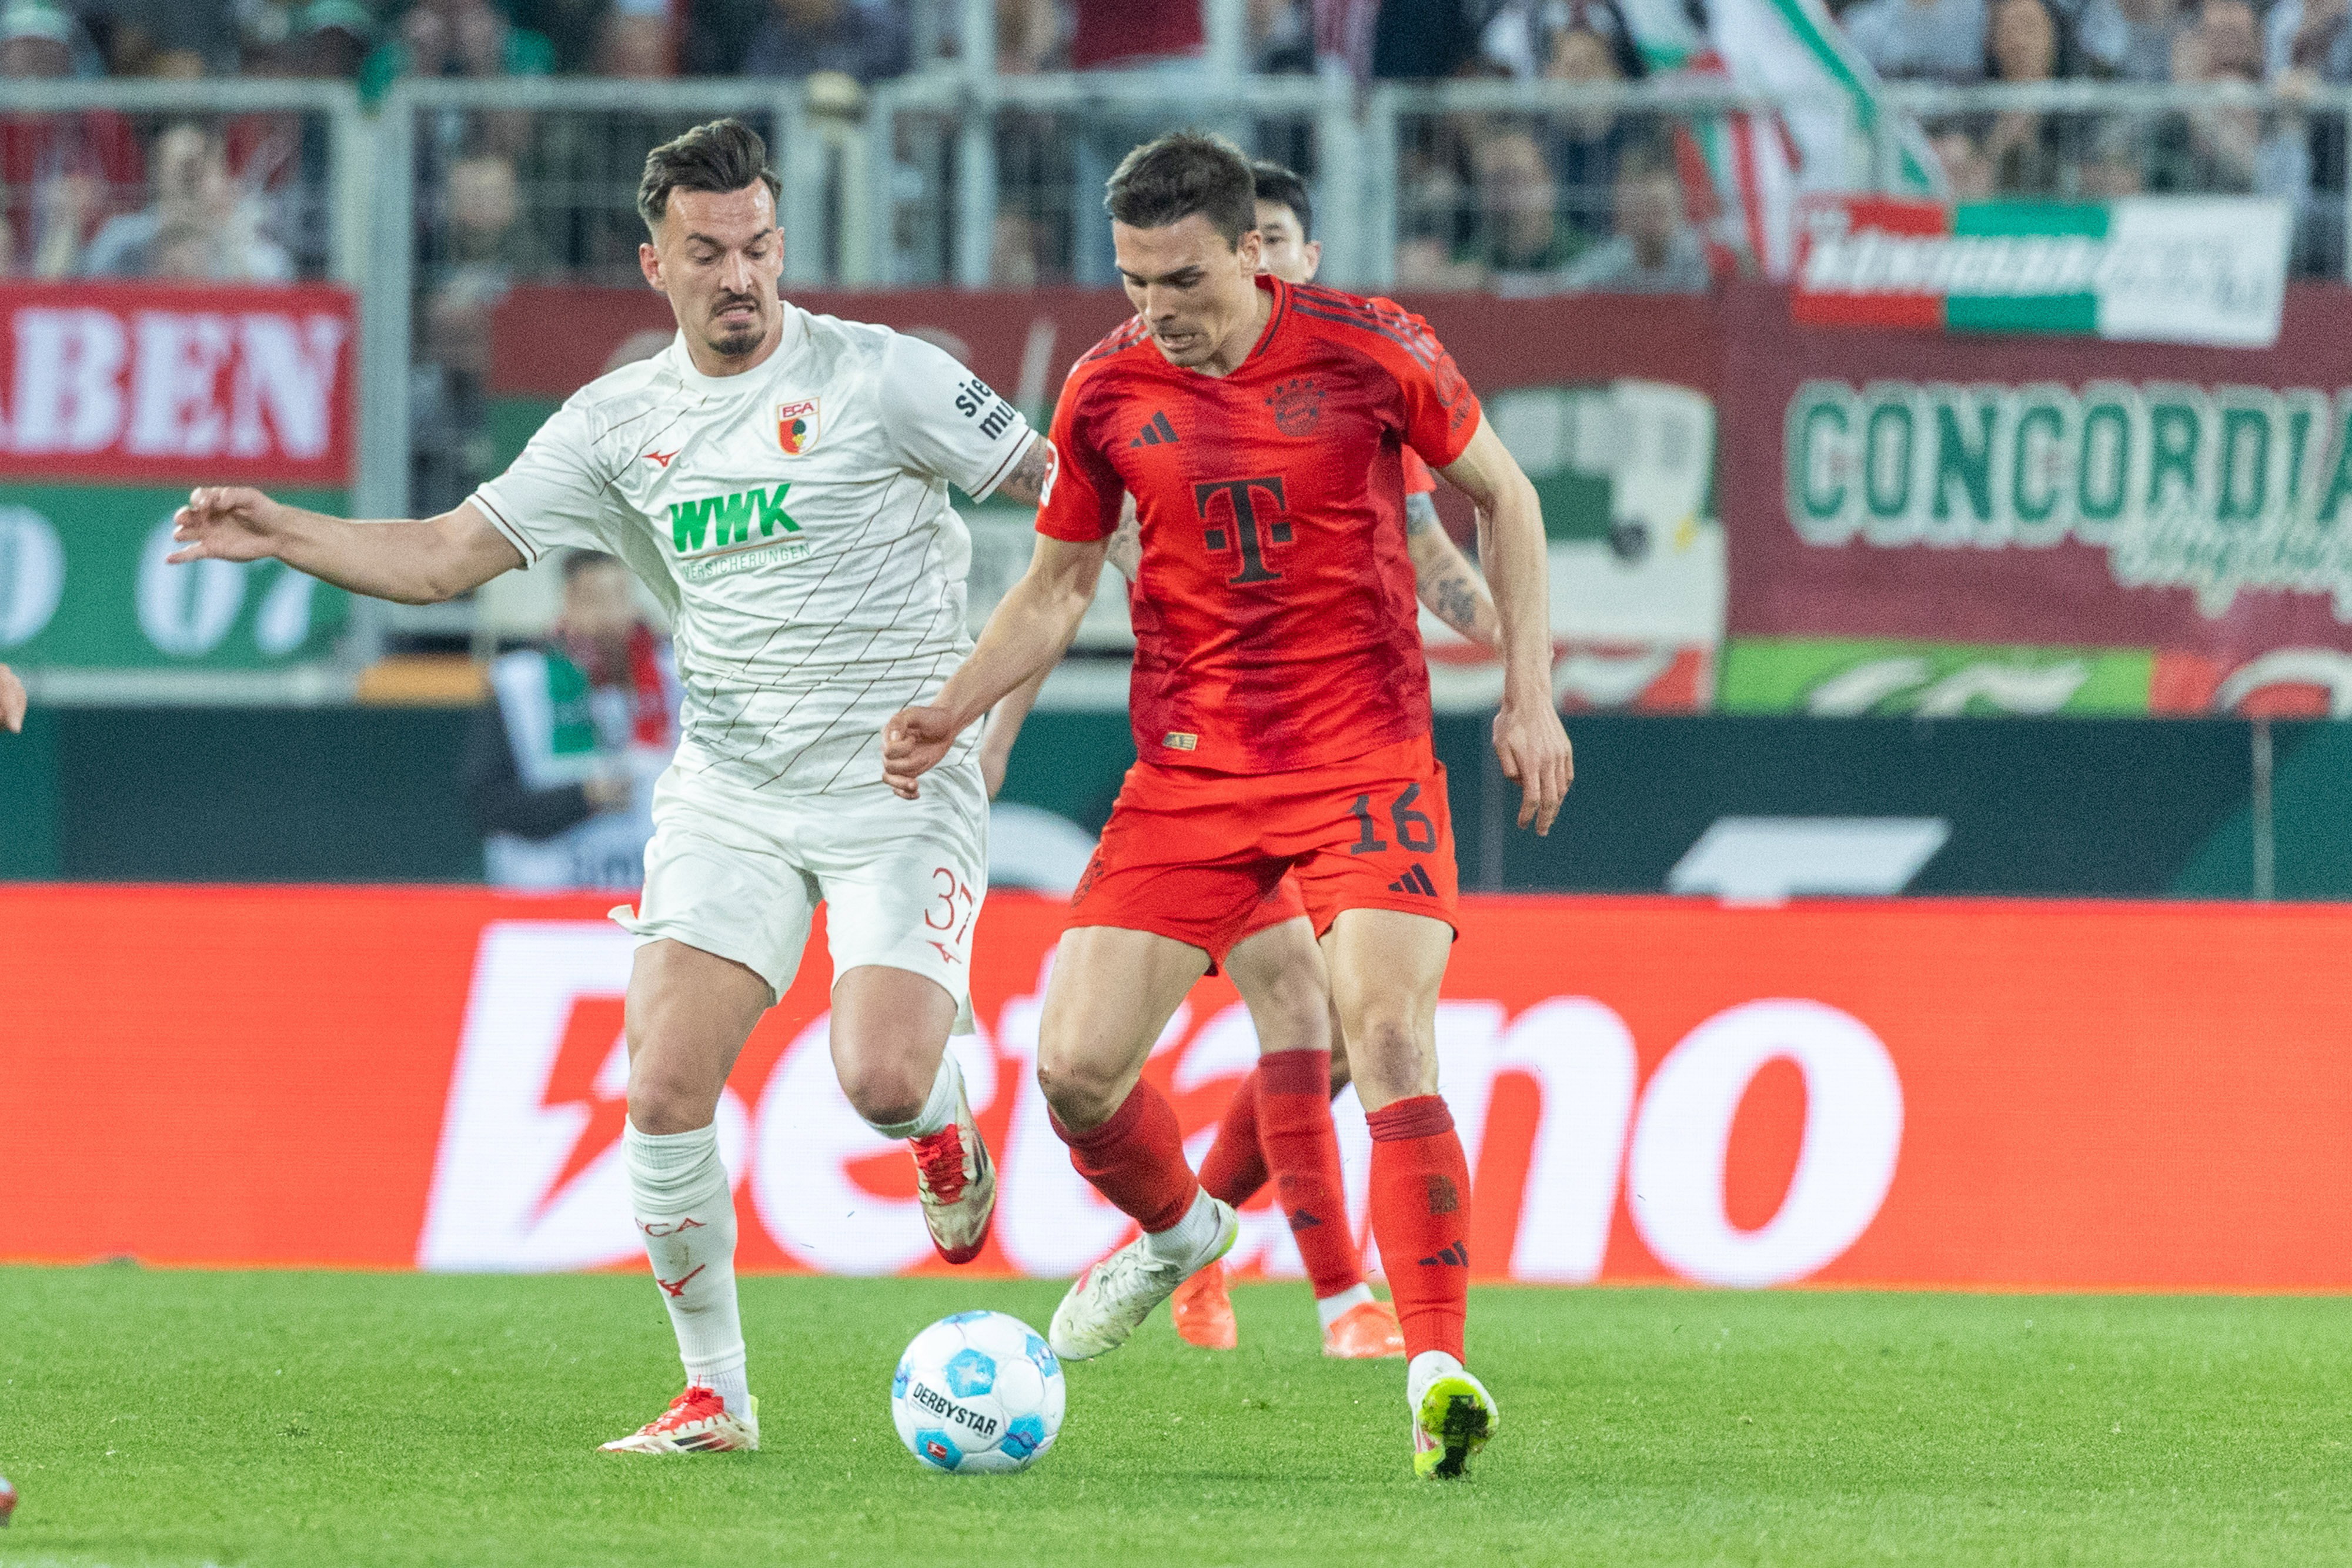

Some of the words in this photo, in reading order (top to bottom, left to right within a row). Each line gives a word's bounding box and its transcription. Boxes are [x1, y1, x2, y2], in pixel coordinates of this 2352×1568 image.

[0, 307, 346, 460] BEN
[668, 482, 803, 553] WWK
[682, 542, 811, 579] VERSICHERUNGEN
[1346, 783, 1437, 855] 16
[913, 1382, 998, 1436] DERBYSTAR
